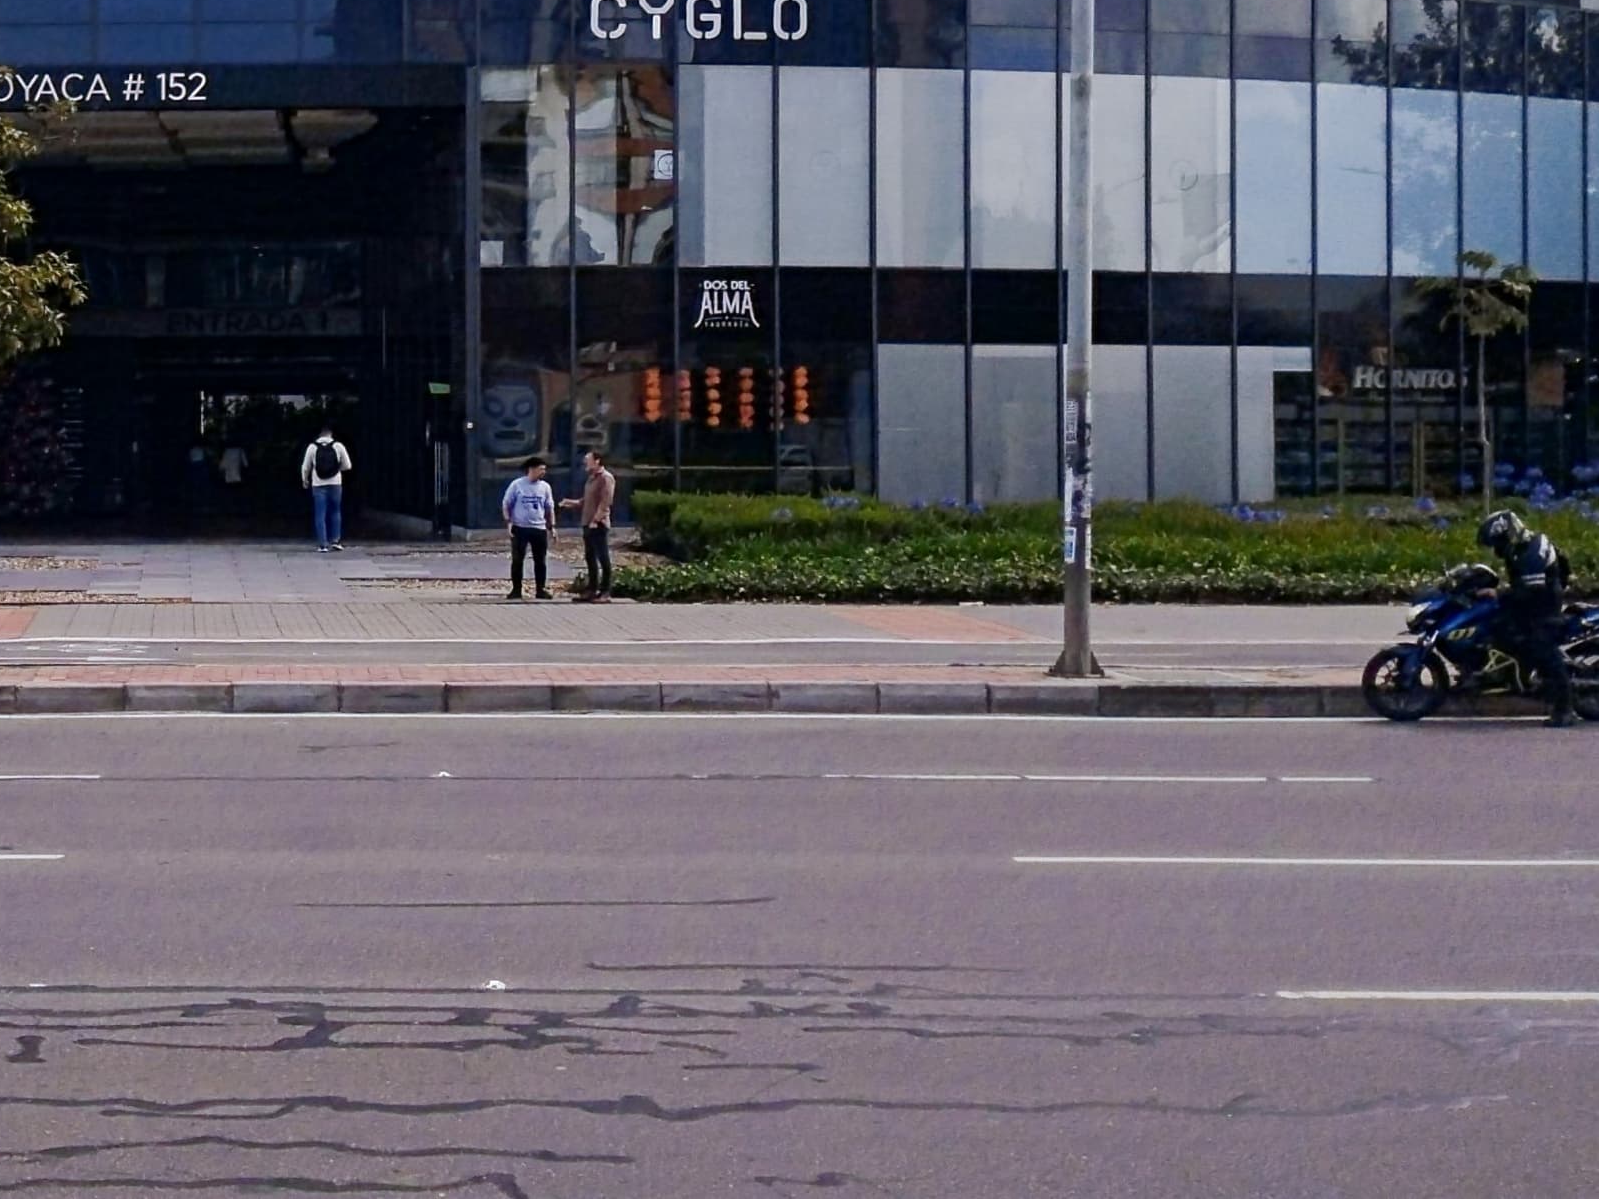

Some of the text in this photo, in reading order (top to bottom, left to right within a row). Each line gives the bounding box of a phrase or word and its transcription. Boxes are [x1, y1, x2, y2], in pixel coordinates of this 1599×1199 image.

[156, 72, 207, 101] 152
[703, 280, 751, 290] DOS DEL
[694, 291, 760, 328] ALMA
